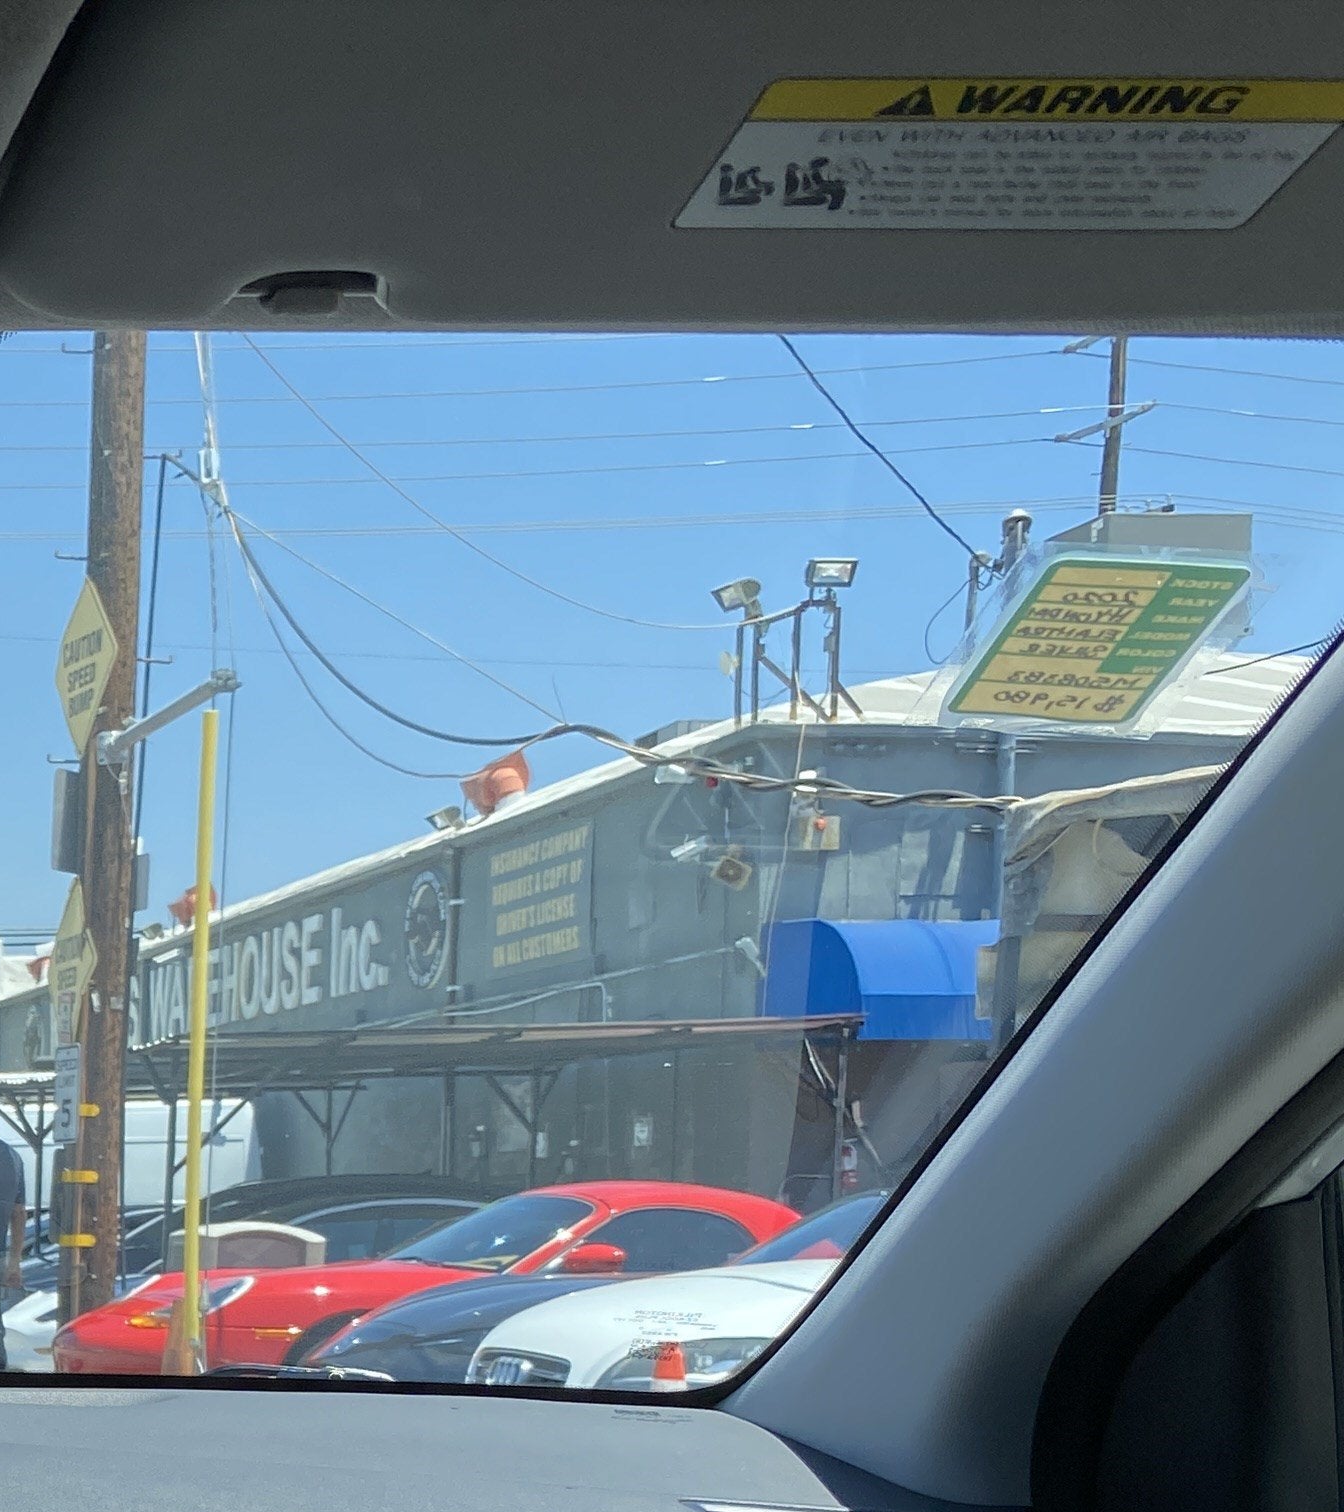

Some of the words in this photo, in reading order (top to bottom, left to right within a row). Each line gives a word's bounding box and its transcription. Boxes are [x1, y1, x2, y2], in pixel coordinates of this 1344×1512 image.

[955, 85, 1250, 115] WARNING
[63, 629, 102, 668] CAUTION
[68, 663, 96, 692] SPEED
[149, 913, 324, 1037] WAEHOUSE
[330, 906, 389, 998] Inc.
[61, 1099, 71, 1127] 5
